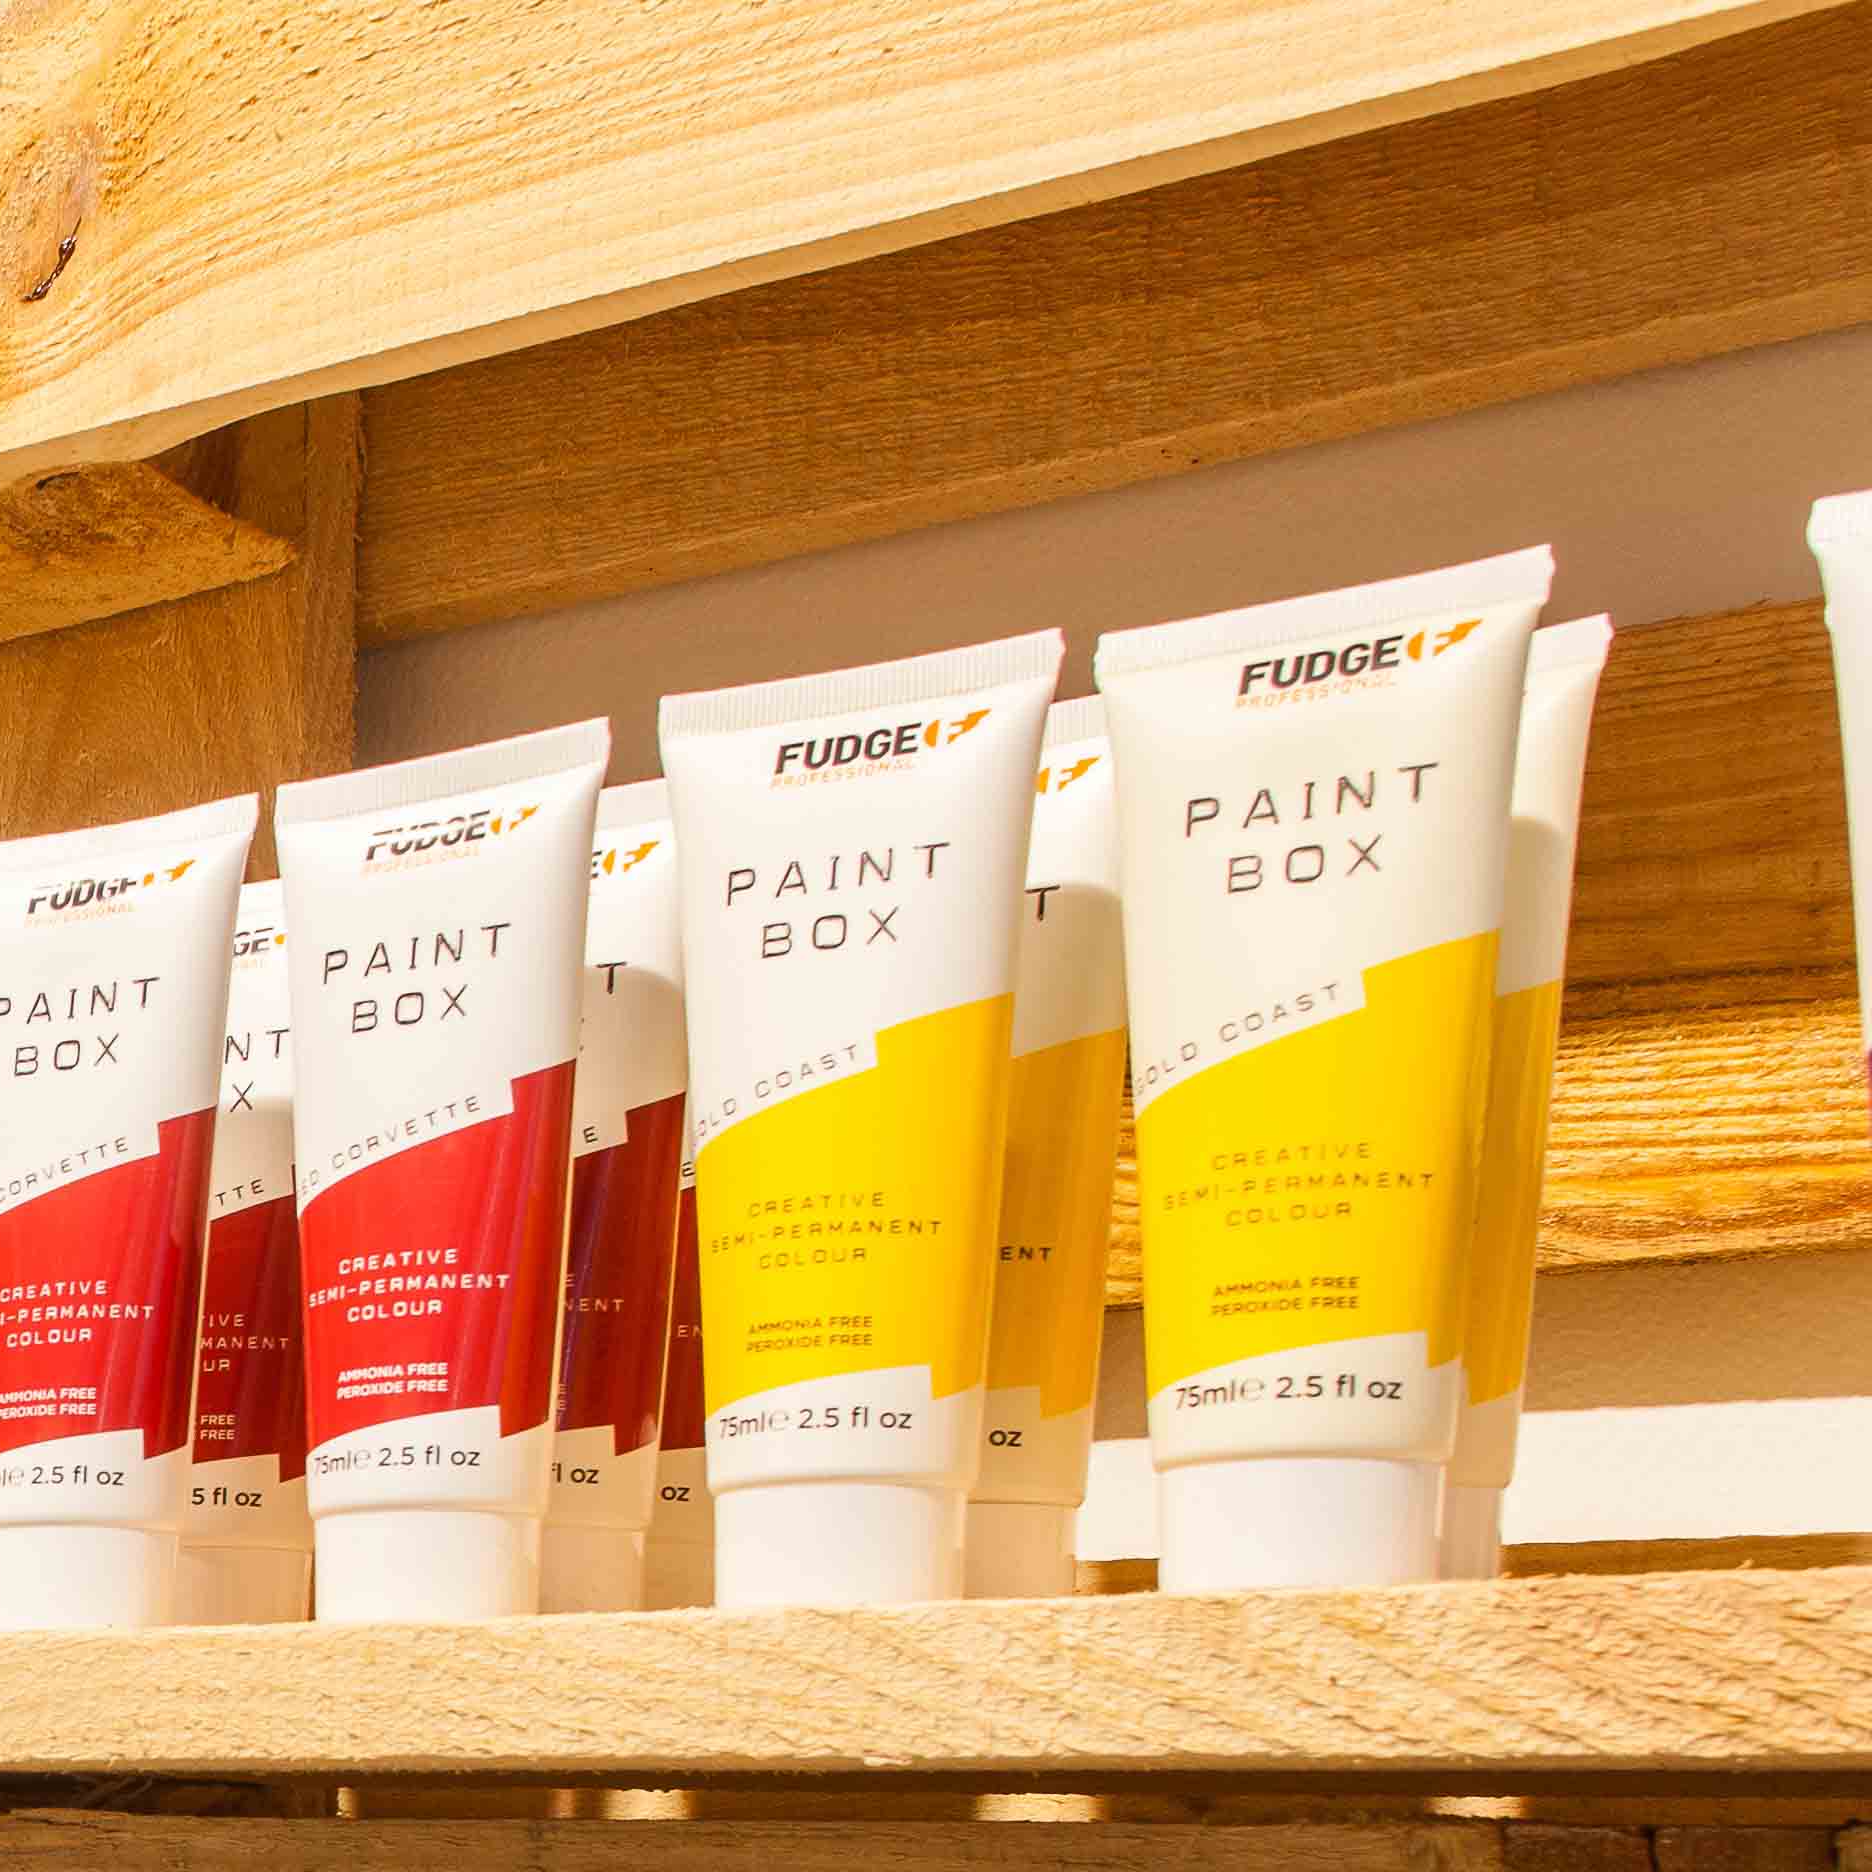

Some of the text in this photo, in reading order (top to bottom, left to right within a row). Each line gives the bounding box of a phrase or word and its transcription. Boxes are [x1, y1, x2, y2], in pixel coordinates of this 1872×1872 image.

[1237, 634, 1405, 697] FUDGE
[774, 721, 922, 775] FUDGE
[1186, 762, 1439, 838] PAINT
[727, 841, 950, 907] PAINT
[1227, 834, 1382, 894] BOX
[761, 905, 899, 959] BOX
[323, 922, 511, 985] PAINT
[351, 984, 468, 1034] BOX
[1218, 983, 1340, 1044] COAST
[14, 1033, 120, 1078] BOX
[754, 1044, 859, 1099] COAST
[331, 1096, 482, 1170] CORVETTE
[1212, 1142, 1372, 1171] CREATIVE
[748, 1191, 886, 1218] CREATIVE
[1164, 1173, 1436, 1211] SEMI-PERMANENT
[1226, 1202, 1352, 1227] COLOUR
[711, 1220, 943, 1254] SEMI-PERMANENT
[338, 1248, 459, 1275] CREATIVE
[759, 1246, 866, 1270] COLOUR
[0, 1280, 108, 1303] CREATIVE
[308, 1274, 511, 1309] SEMI-PERMANENT
[1213, 1276, 1361, 1296] AMMONIA FREE
[346, 1300, 443, 1323] COLOUR
[1211, 1295, 1360, 1317] PEROXIDE FREE
[6, 1328, 93, 1349] COLOUR
[748, 1316, 873, 1336] AMMONIA FREE
[746, 1334, 873, 1353] PEROXIDE FREE
[338, 1363, 448, 1384] AMMONIA FREE
[1276, 1374, 1324, 1400] 2.5
[1336, 1373, 1355, 1398] fl
[1367, 1379, 1403, 1400] oz
[60, 1387, 97, 1400] FREE
[336, 1379, 448, 1400] PEROXIDE FREE
[59, 1403, 97, 1416] FREE
[798, 1407, 839, 1430] 2.5
[851, 1406, 869, 1428] fl
[880, 1410, 913, 1430] oz
[379, 1445, 481, 1467] 2.5 fl oz
[31, 1465, 125, 1487] 2.5 fl oz
